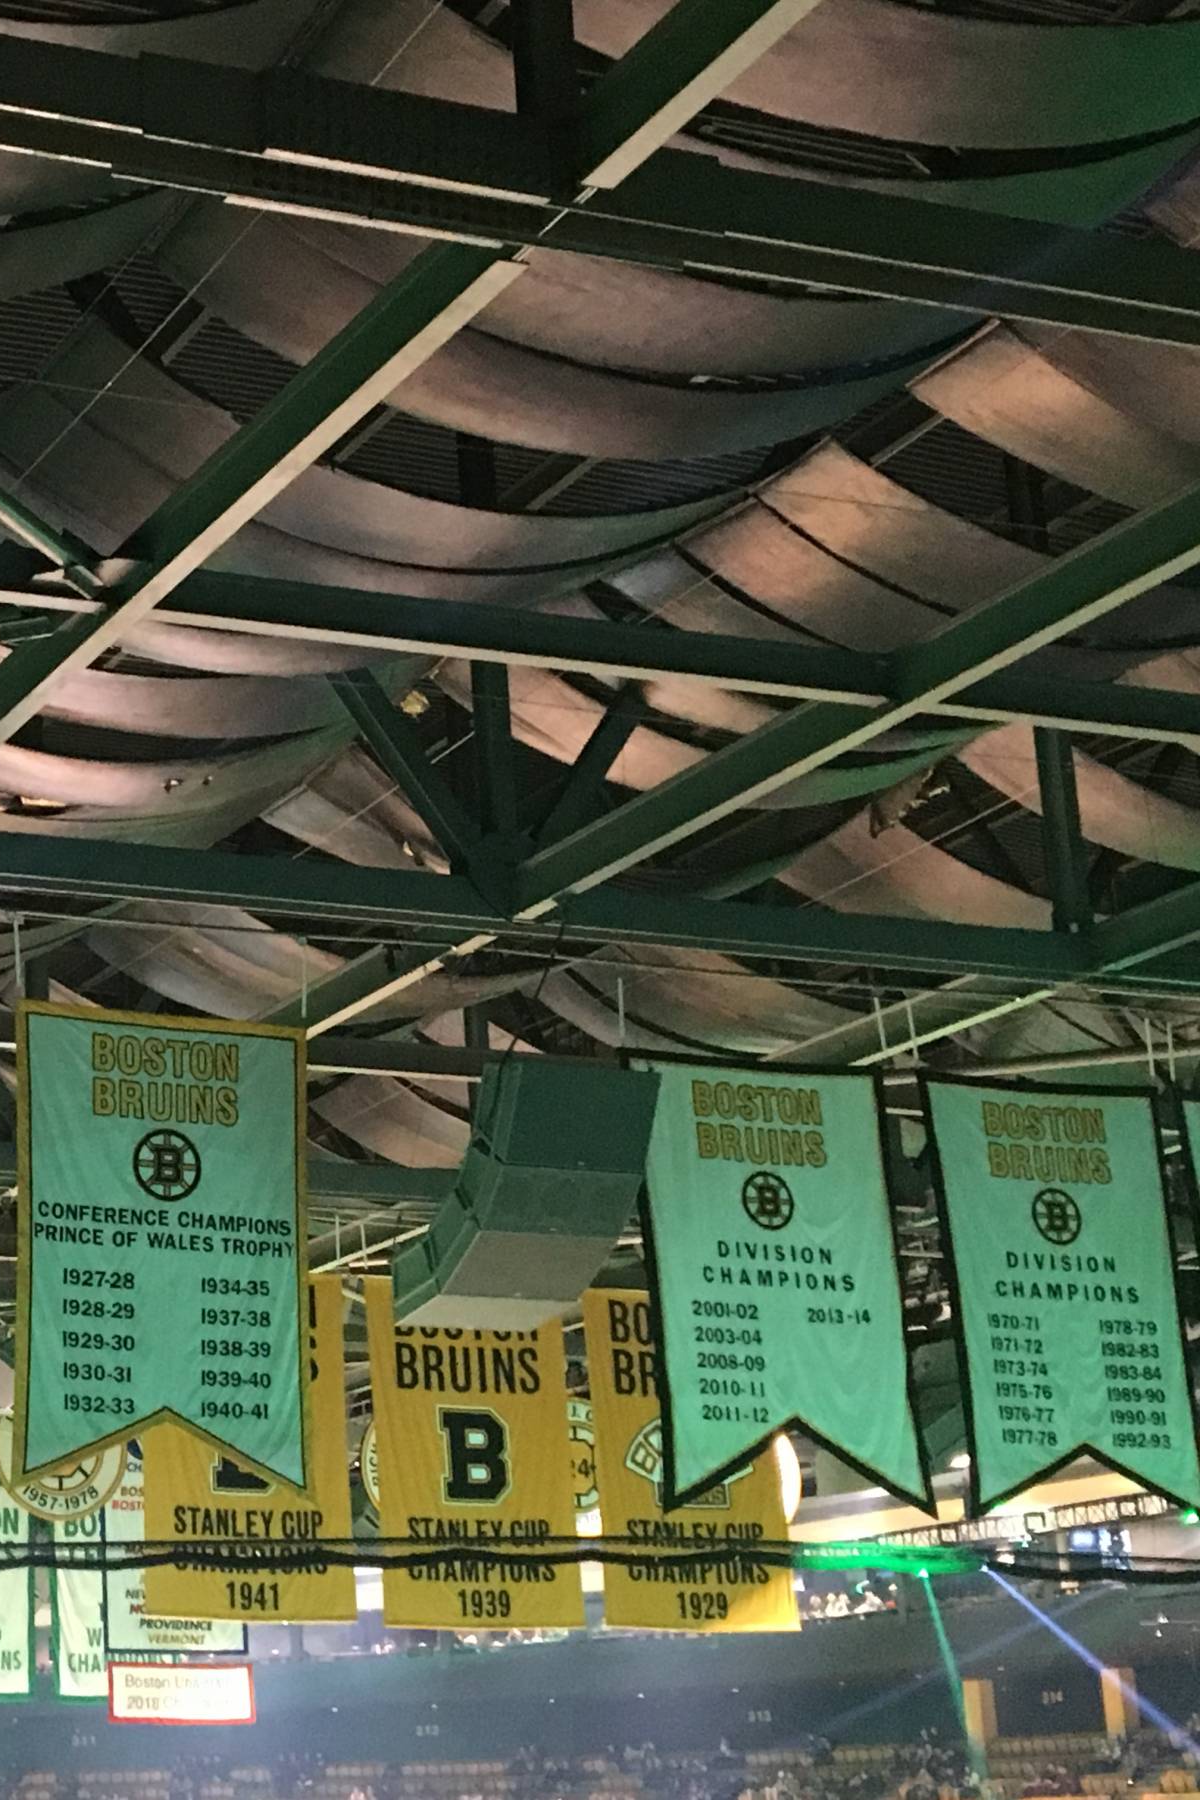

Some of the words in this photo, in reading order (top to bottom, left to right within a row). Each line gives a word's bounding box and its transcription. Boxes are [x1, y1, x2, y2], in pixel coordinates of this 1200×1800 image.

[92, 1032, 239, 1083] BOSTON
[92, 1077, 239, 1127] BRUINS
[691, 1079, 823, 1126] BOSTON
[982, 1100, 1108, 1144] BOSTON
[696, 1121, 828, 1169] BRUINS
[987, 1141, 1113, 1185] BRUINS
[37, 1201, 169, 1227] CONFERENCE
[177, 1211, 292, 1236] CHAMPIONS
[34, 1222, 103, 1247] PRINCE
[112, 1231, 138, 1248] OF
[147, 1233, 214, 1253] WALES
[222, 1238, 295, 1258] TROPHY
[717, 1240, 833, 1265] DIVISION
[1006, 1250, 1117, 1273] DIVISION
[63, 1268, 135, 1290] 1927-28
[201, 1278, 270, 1296] 1934-35
[703, 1265, 856, 1292] CHAMPIONS
[995, 1280, 1141, 1304] CHAMPIONS
[63, 1299, 135, 1320] 1928-29
[201, 1308, 271, 1328] 1937-38
[692, 1300, 759, 1320] 2001-02
[807, 1308, 871, 1325] 2013-14
[63, 1331, 135, 1352] 1929-30
[694, 1326, 763, 1345] 2003-04
[201, 1339, 271, 1358] 1938-39
[63, 1362, 132, 1383] 1930-31
[395, 1342, 541, 1394] BRUINS
[697, 1352, 766, 1372] 2008-09
[201, 1370, 272, 1389] 1939-40
[699, 1378, 766, 1398] 2010-11
[64, 1394, 135, 1414] 1932-33
[201, 1401, 269, 1420] 1940-41
[702, 1404, 770, 1423] 2011-12
[437, 1404, 512, 1507] B
[22, 1485, 100, 1511] 1957-1978
[174, 1505, 274, 1538] STANLEY
[281, 1511, 323, 1539] CUP
[408, 1517, 503, 1543] STANLEY
[510, 1519, 550, 1546] CUP
[627, 1519, 716, 1548] STANLEY
[726, 1523, 764, 1549] CUP
[408, 1556, 557, 1583] CHAMPIONS
[629, 1561, 771, 1585] CHAMPIONS
[226, 1581, 280, 1611] 1941
[458, 1590, 512, 1617] 1939
[677, 1591, 729, 1620] 1929
[139, 1619, 213, 1631] PROVIDENCE
[148, 1634, 206, 1645] VERMONT
[125, 1674, 171, 1689] Boston
